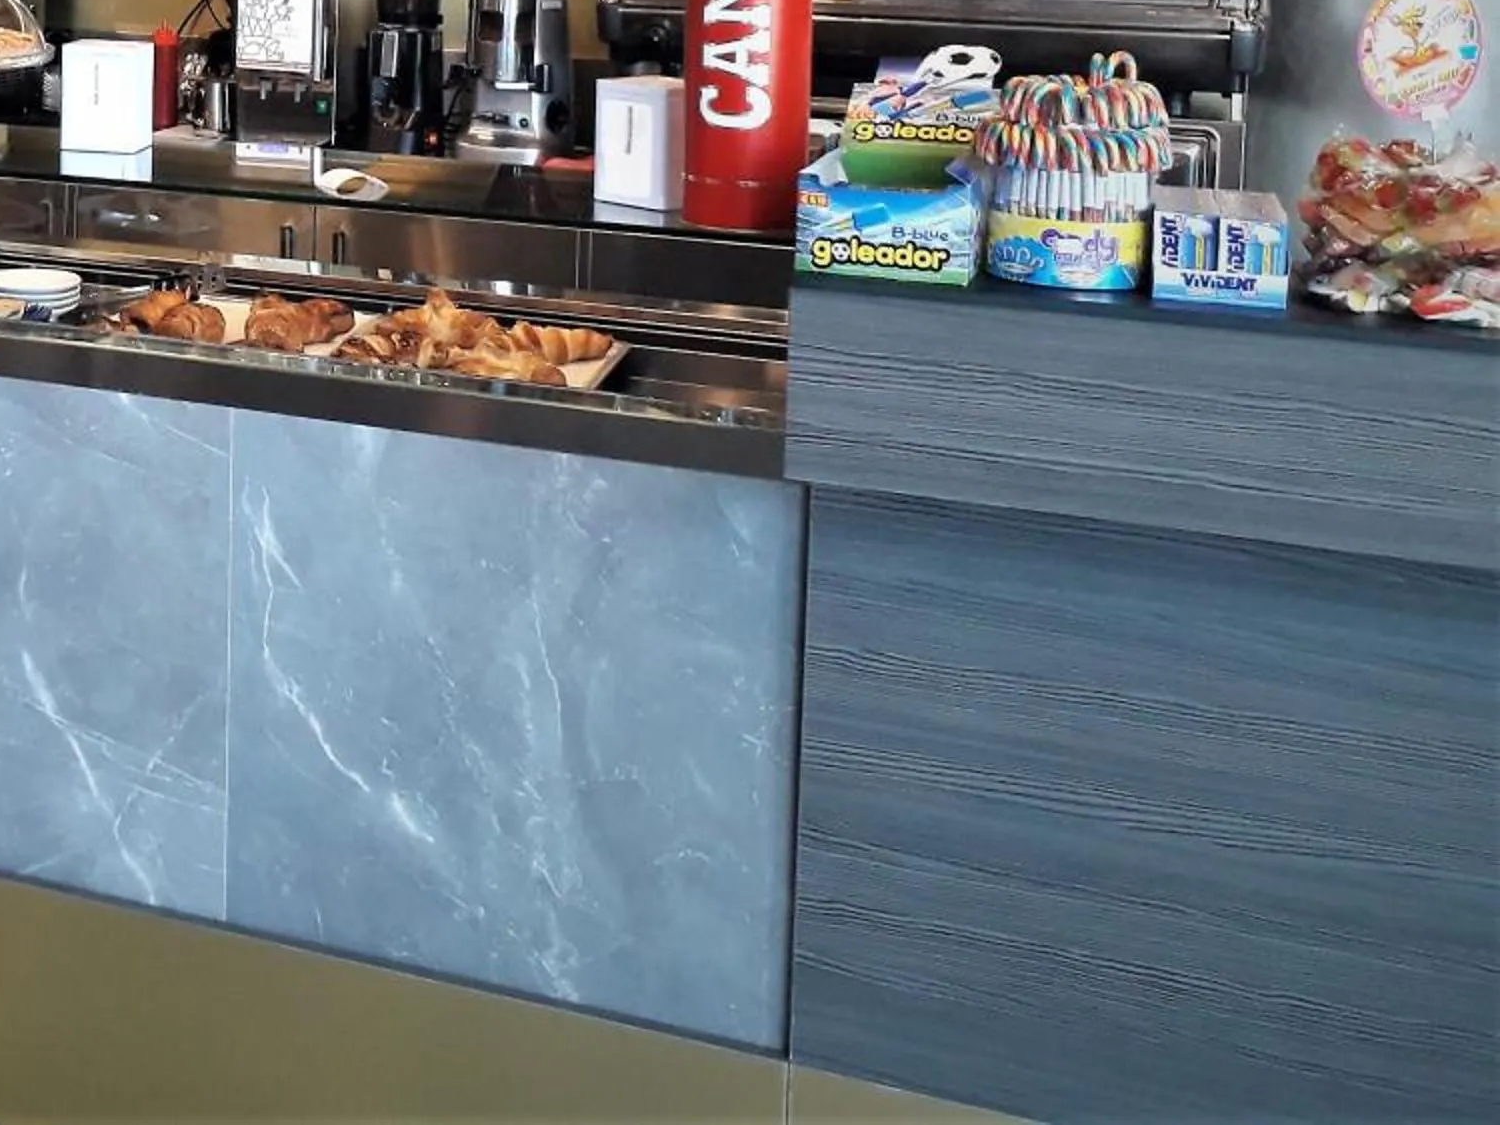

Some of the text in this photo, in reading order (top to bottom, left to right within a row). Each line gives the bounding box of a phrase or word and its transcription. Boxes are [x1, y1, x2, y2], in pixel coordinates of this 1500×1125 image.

[854, 121, 974, 142] goleado
[891, 225, 949, 243] B-blue
[1041, 228, 1118, 263] Cdy
[812, 236, 950, 270] goleador
